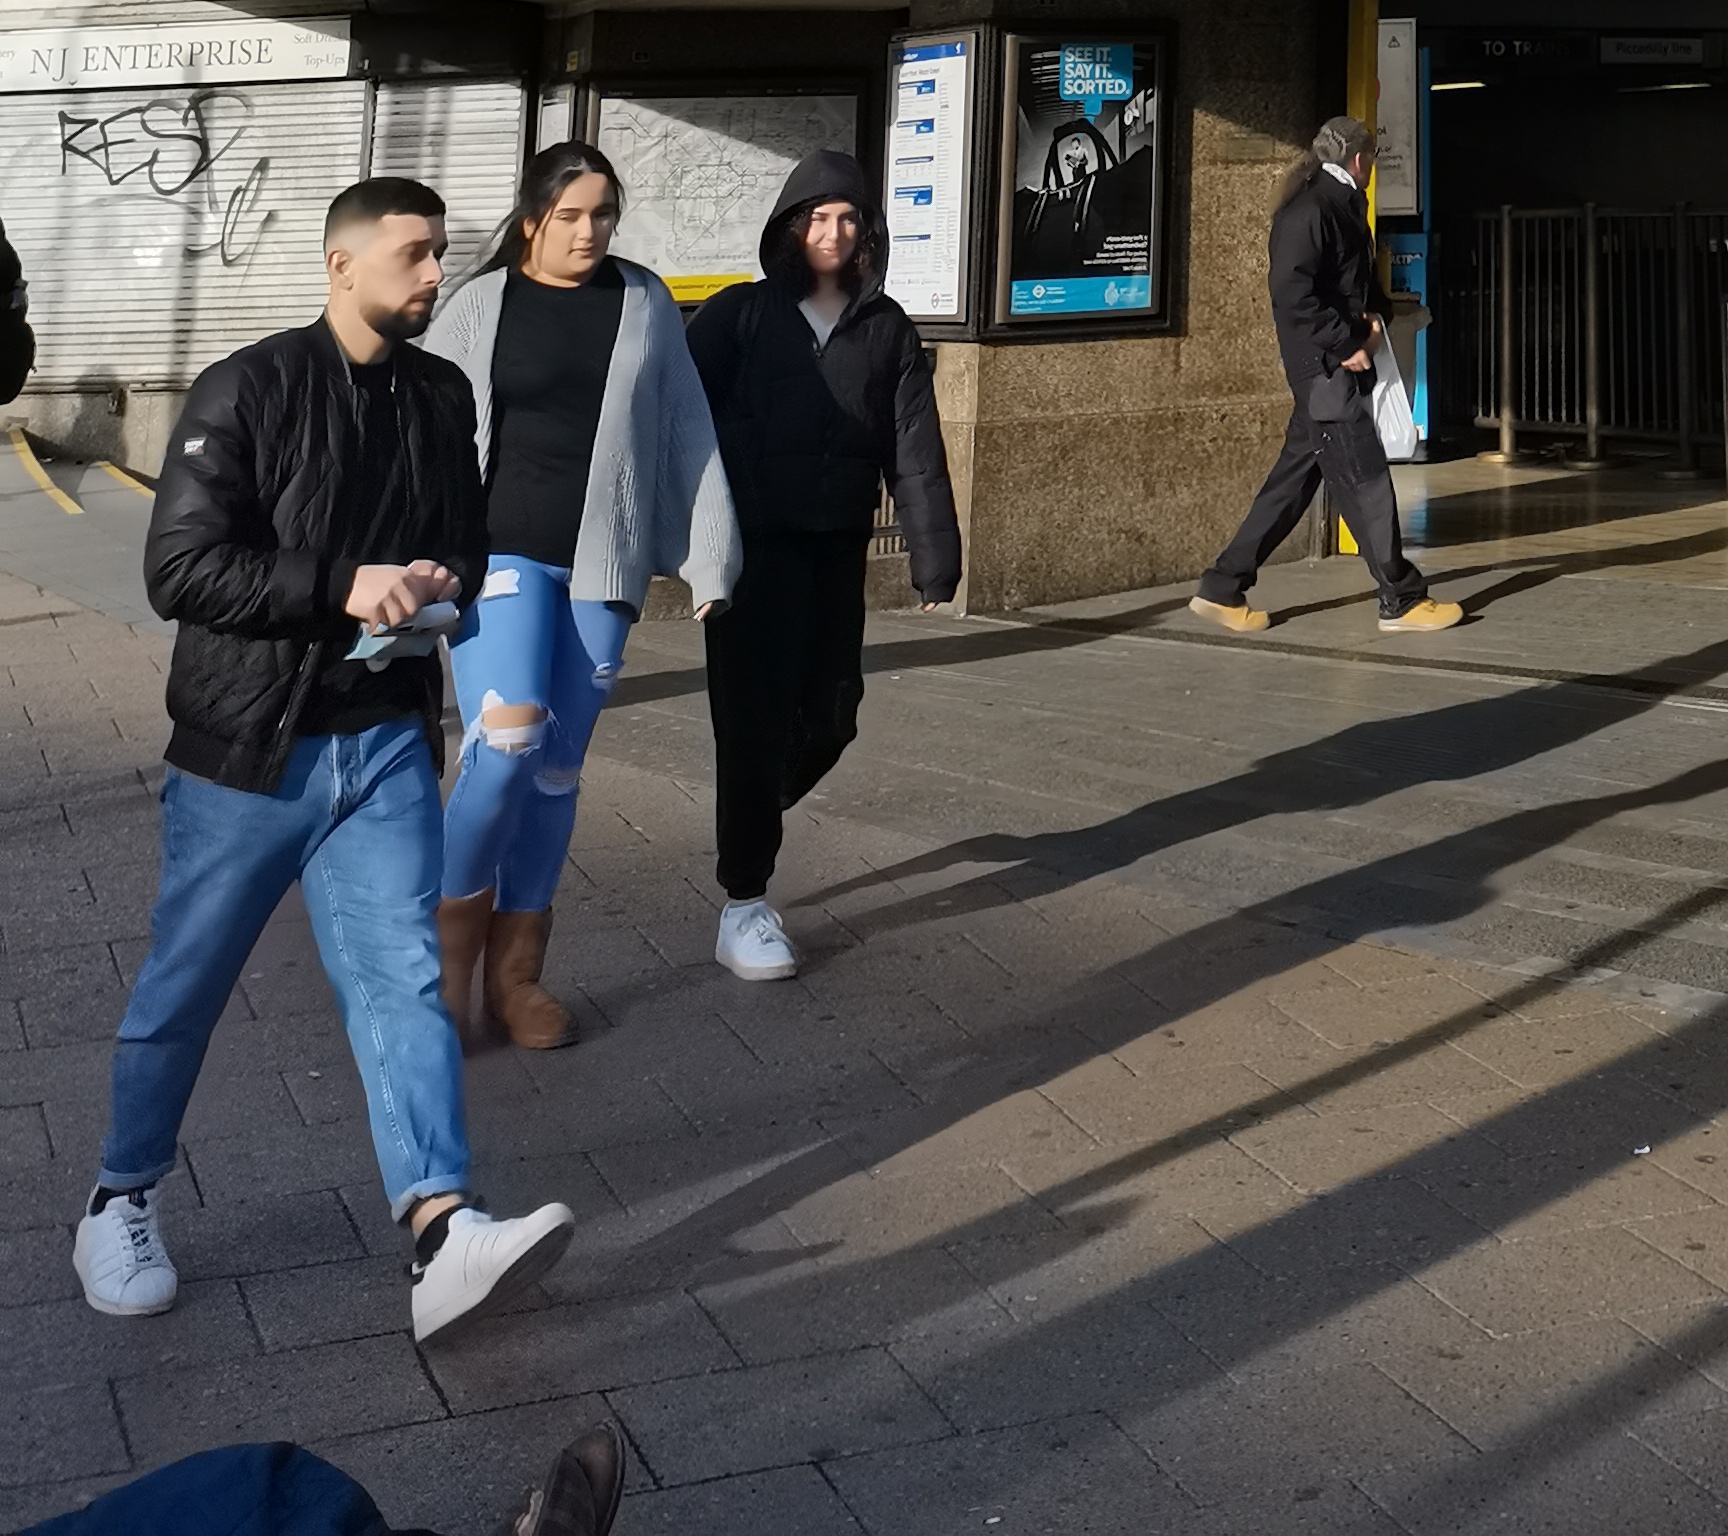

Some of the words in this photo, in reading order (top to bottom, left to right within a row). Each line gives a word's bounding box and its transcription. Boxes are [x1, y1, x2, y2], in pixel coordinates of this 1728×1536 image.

[1064, 46, 1094, 62] SEE
[1095, 46, 1113, 62] IT.
[1482, 39, 1506, 57] TO
[1616, 42, 1668, 58] Piccadilly
[30, 47, 70, 82] NJ
[82, 37, 274, 73] ENTERPRISE
[304, 53, 346, 69] Top-Ups
[1064, 63, 1093, 79] SAY
[1094, 63, 1113, 79] IT.
[1063, 78, 1131, 95] SORTED.
